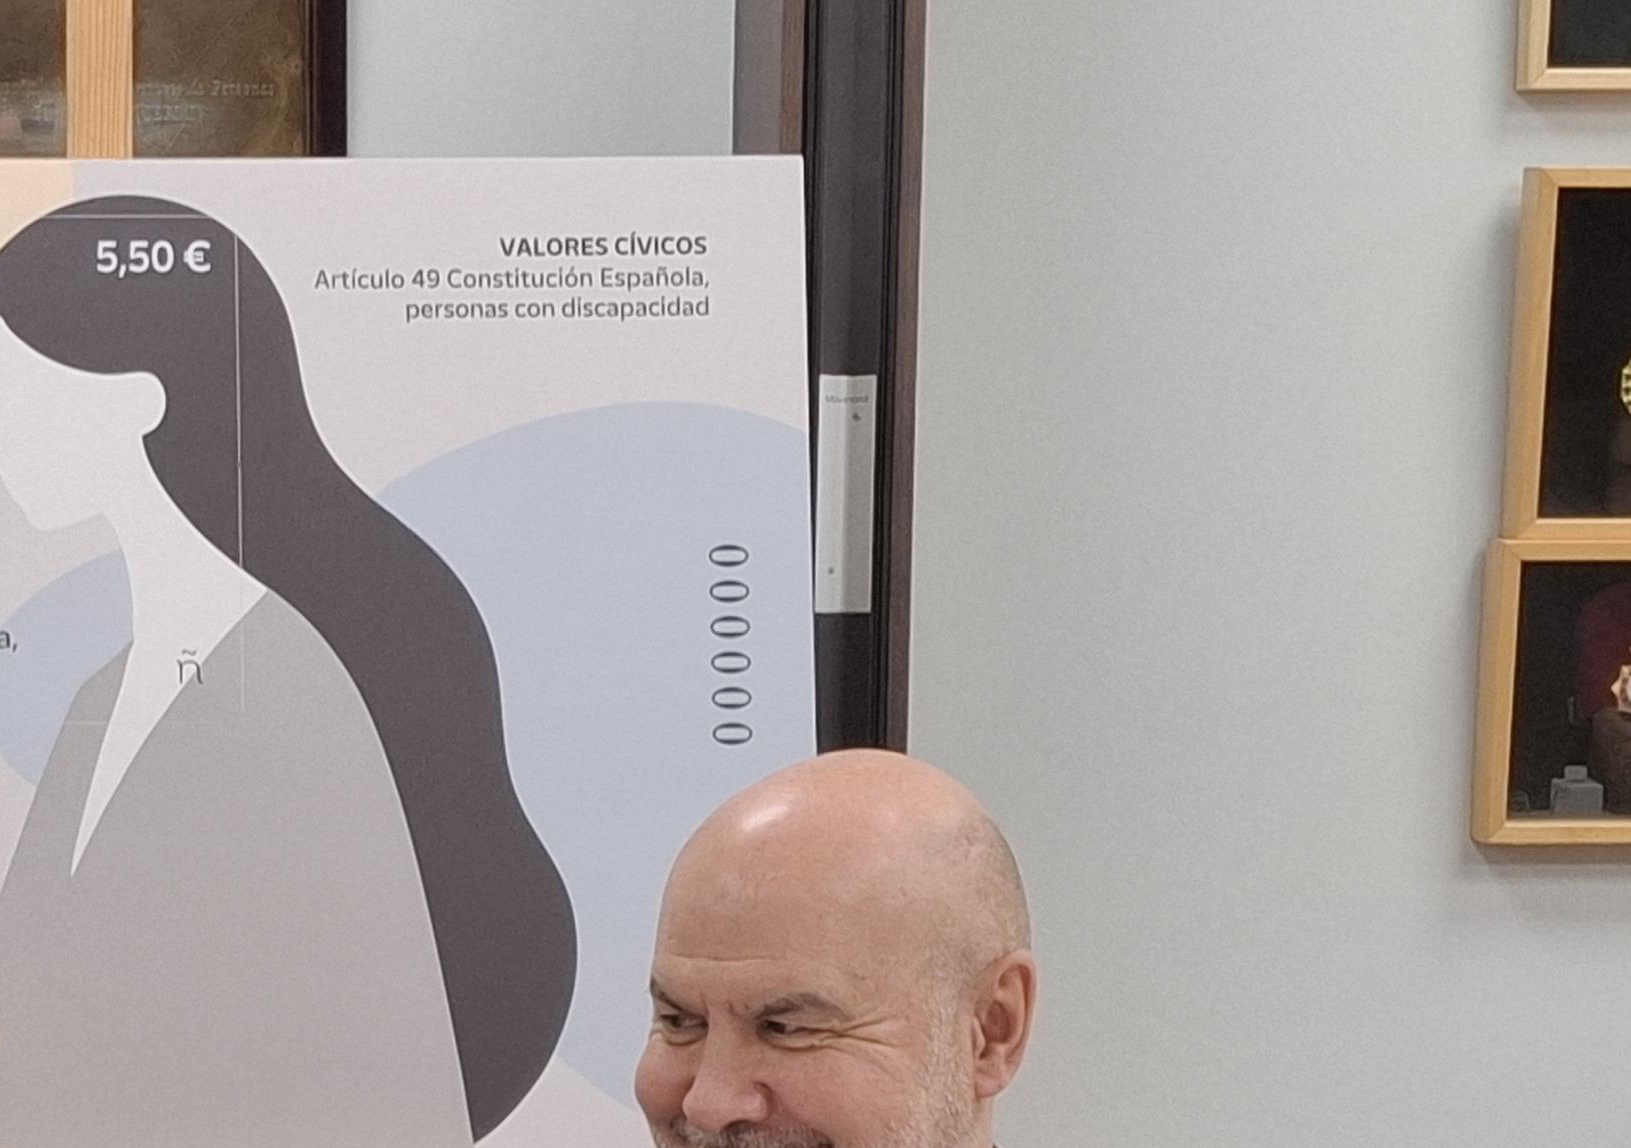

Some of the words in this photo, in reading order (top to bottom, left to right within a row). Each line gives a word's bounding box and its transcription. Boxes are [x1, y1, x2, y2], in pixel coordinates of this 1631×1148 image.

[499, 236, 609, 257] VALORES
[614, 230, 708, 257] CÍVICOS
[96, 240, 174, 278] 5,50
[183, 240, 211, 273] €
[314, 267, 405, 290] Artículo
[411, 268, 441, 290] 49
[446, 265, 593, 290] Constitución
[600, 265, 710, 294] Española,
[405, 302, 509, 324] personas
[514, 302, 556, 319] con
[561, 295, 710, 323] discapacidad
